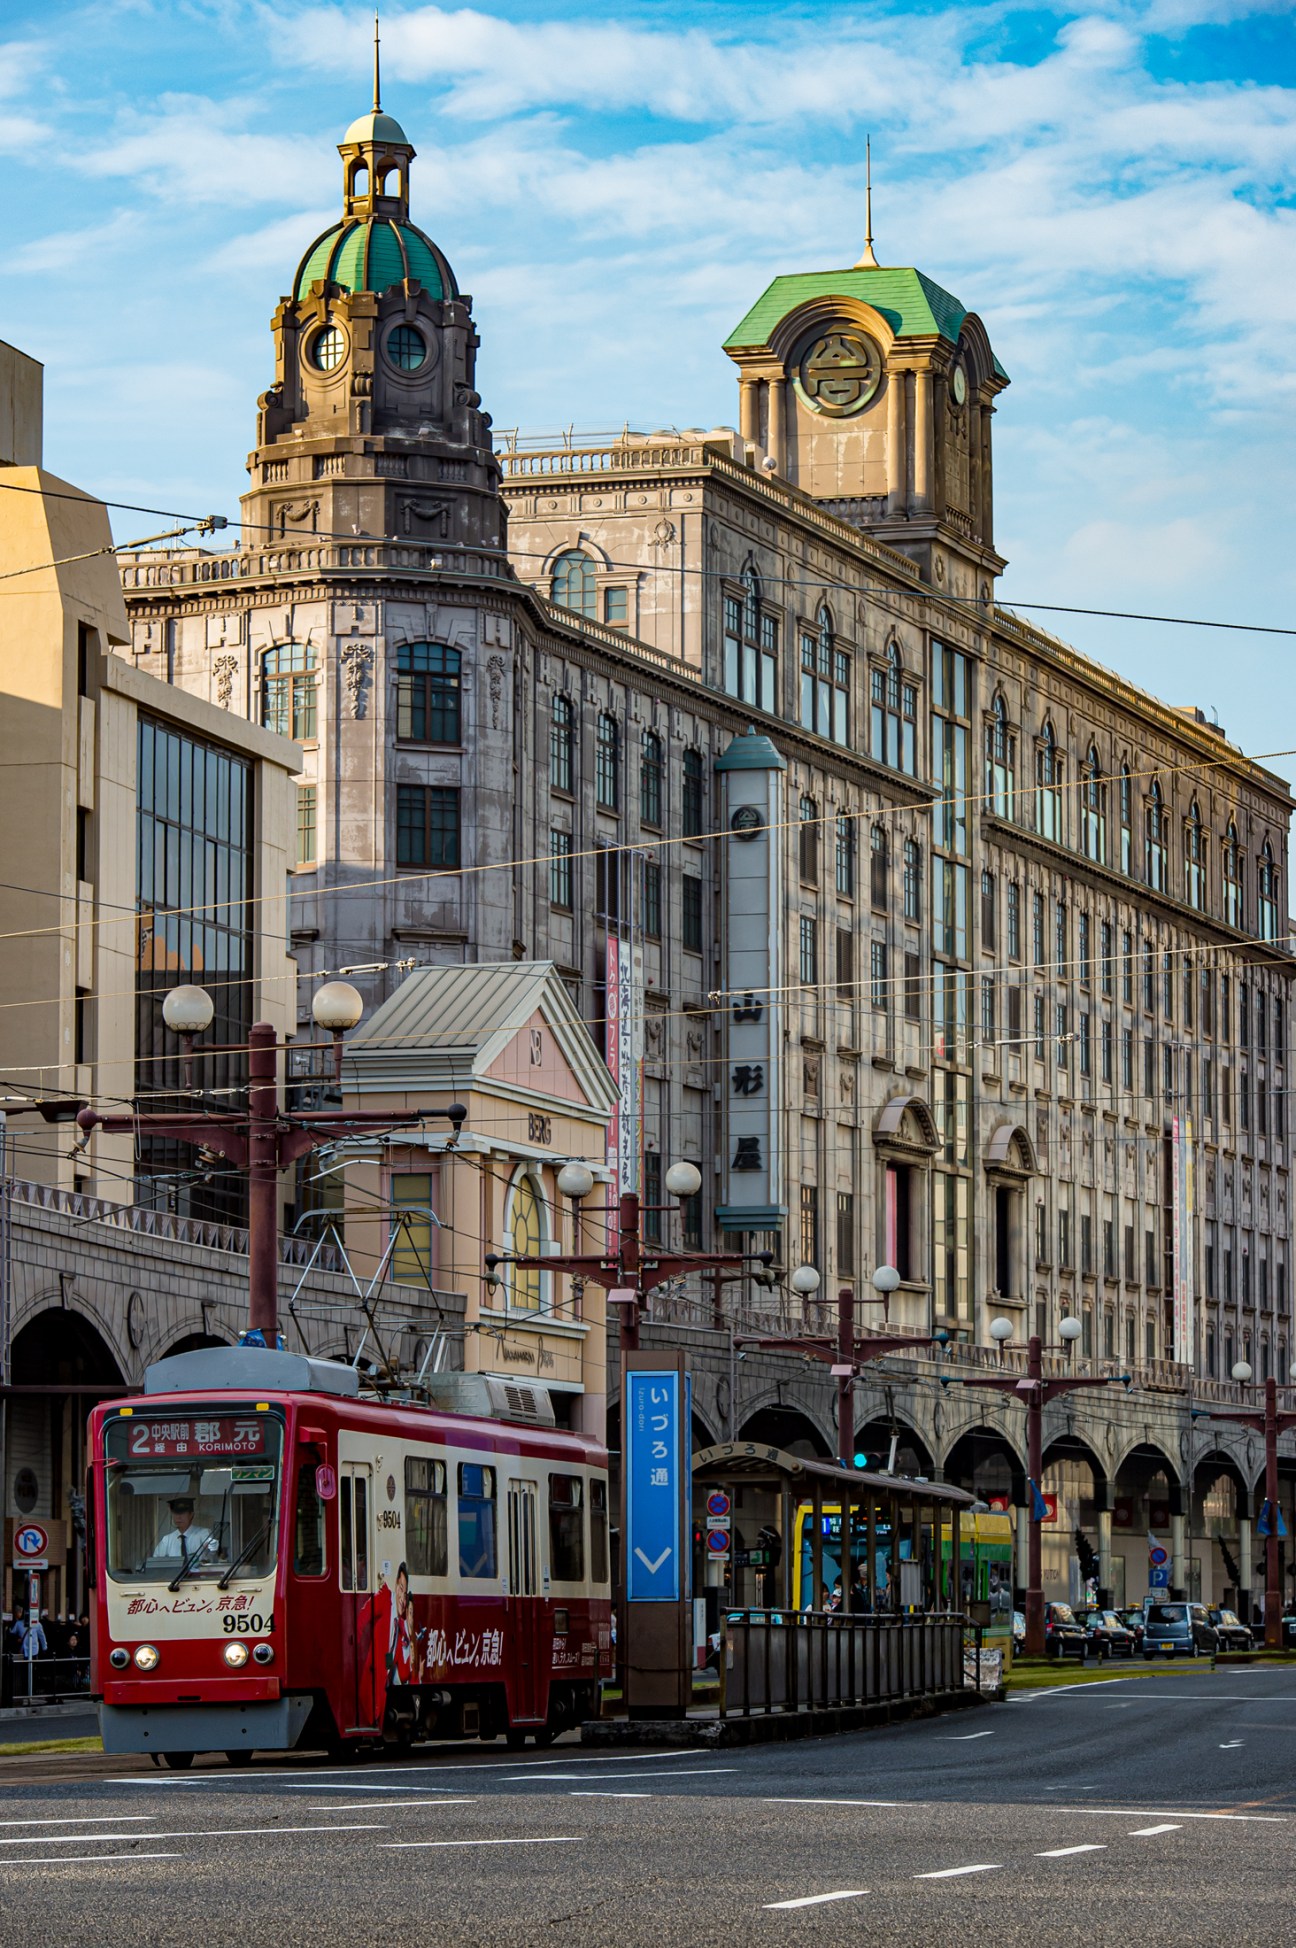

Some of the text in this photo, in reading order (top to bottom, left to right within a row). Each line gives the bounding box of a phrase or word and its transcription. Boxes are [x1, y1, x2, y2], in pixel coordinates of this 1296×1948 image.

[732, 989, 764, 1170] 山形屋
[528, 1112, 552, 1146] BERG
[132, 1424, 150, 1453] 2
[151, 1423, 190, 1440] 中央駅前
[194, 1421, 260, 1443] 郡元
[650, 1387, 669, 1486] いづろ通
[154, 1442, 188, 1453] 経由
[199, 1441, 256, 1452] KORIMOTO
[699, 1443, 779, 1463] いづろ通
[233, 1467, 273, 1480] ワンマン
[382, 1510, 401, 1529] 9504
[1152, 1570, 1164, 1586] P
[222, 1613, 276, 1633] 9504
